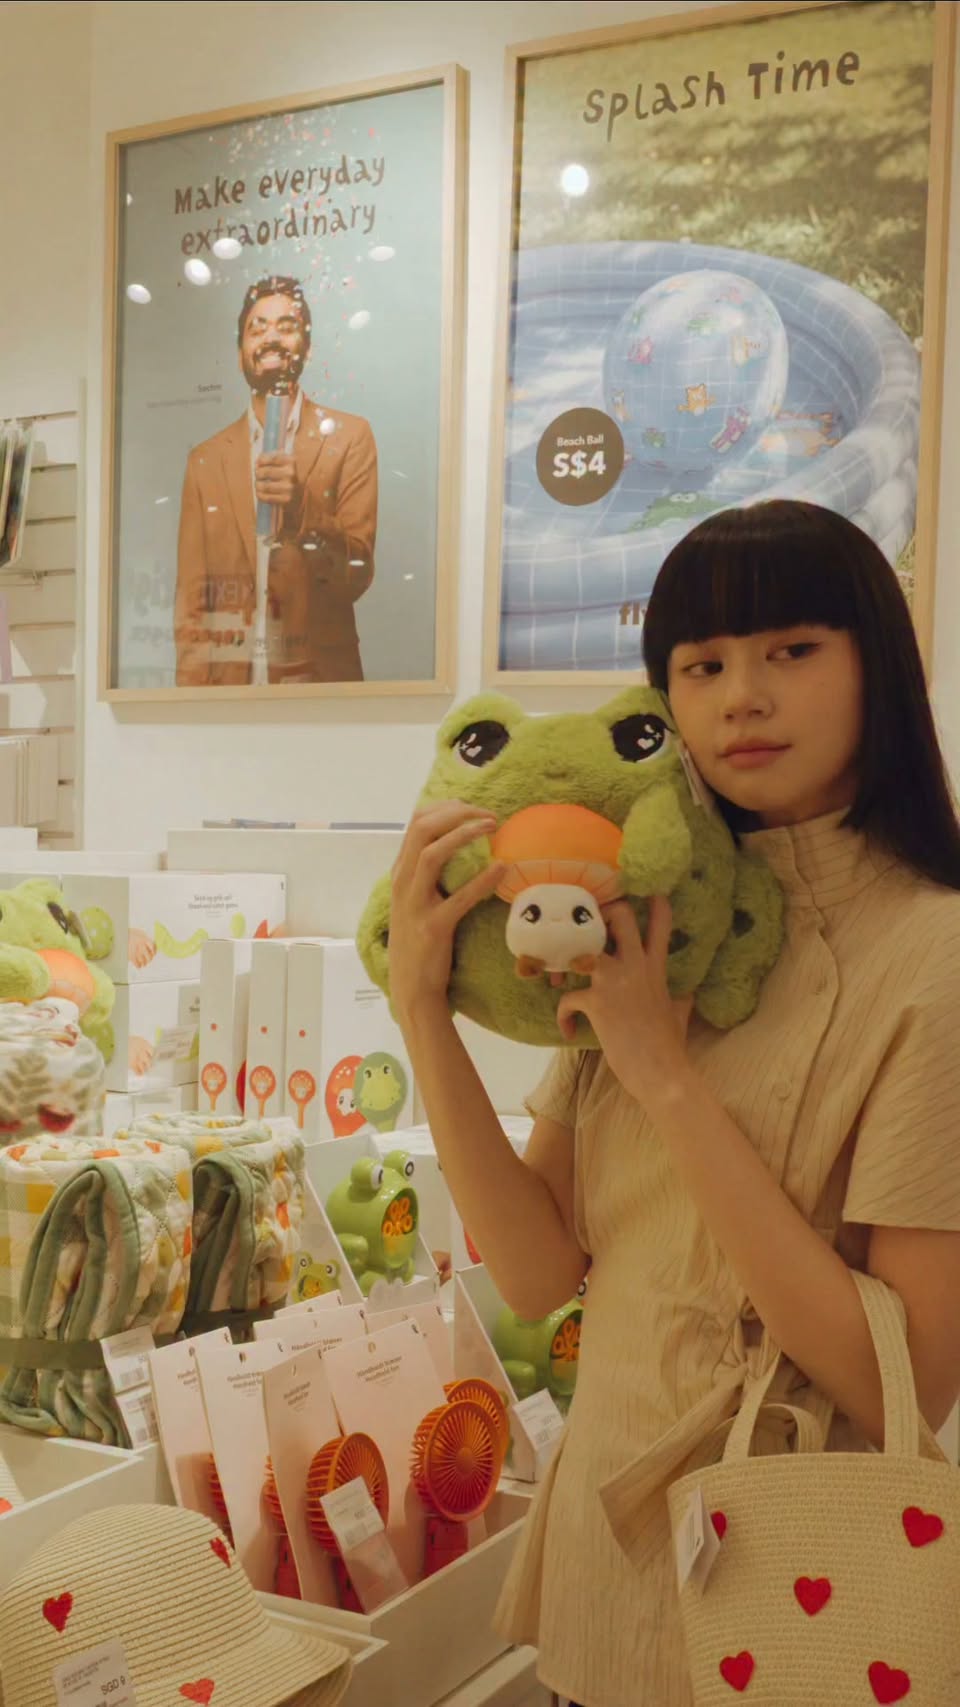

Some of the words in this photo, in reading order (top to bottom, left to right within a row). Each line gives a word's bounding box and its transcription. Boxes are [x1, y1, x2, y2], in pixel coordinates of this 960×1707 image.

[747, 50, 860, 100] Time
[174, 175, 246, 214] Make
[258, 154, 385, 198] everyday
[180, 202, 376, 256] extraordinary
[556, 435, 586, 447] Beach
[586, 433, 604, 445] Ball
[552, 449, 607, 479] S$4
[101, 1678, 120, 1696] SGD
[120, 1675, 126, 1686] 9
